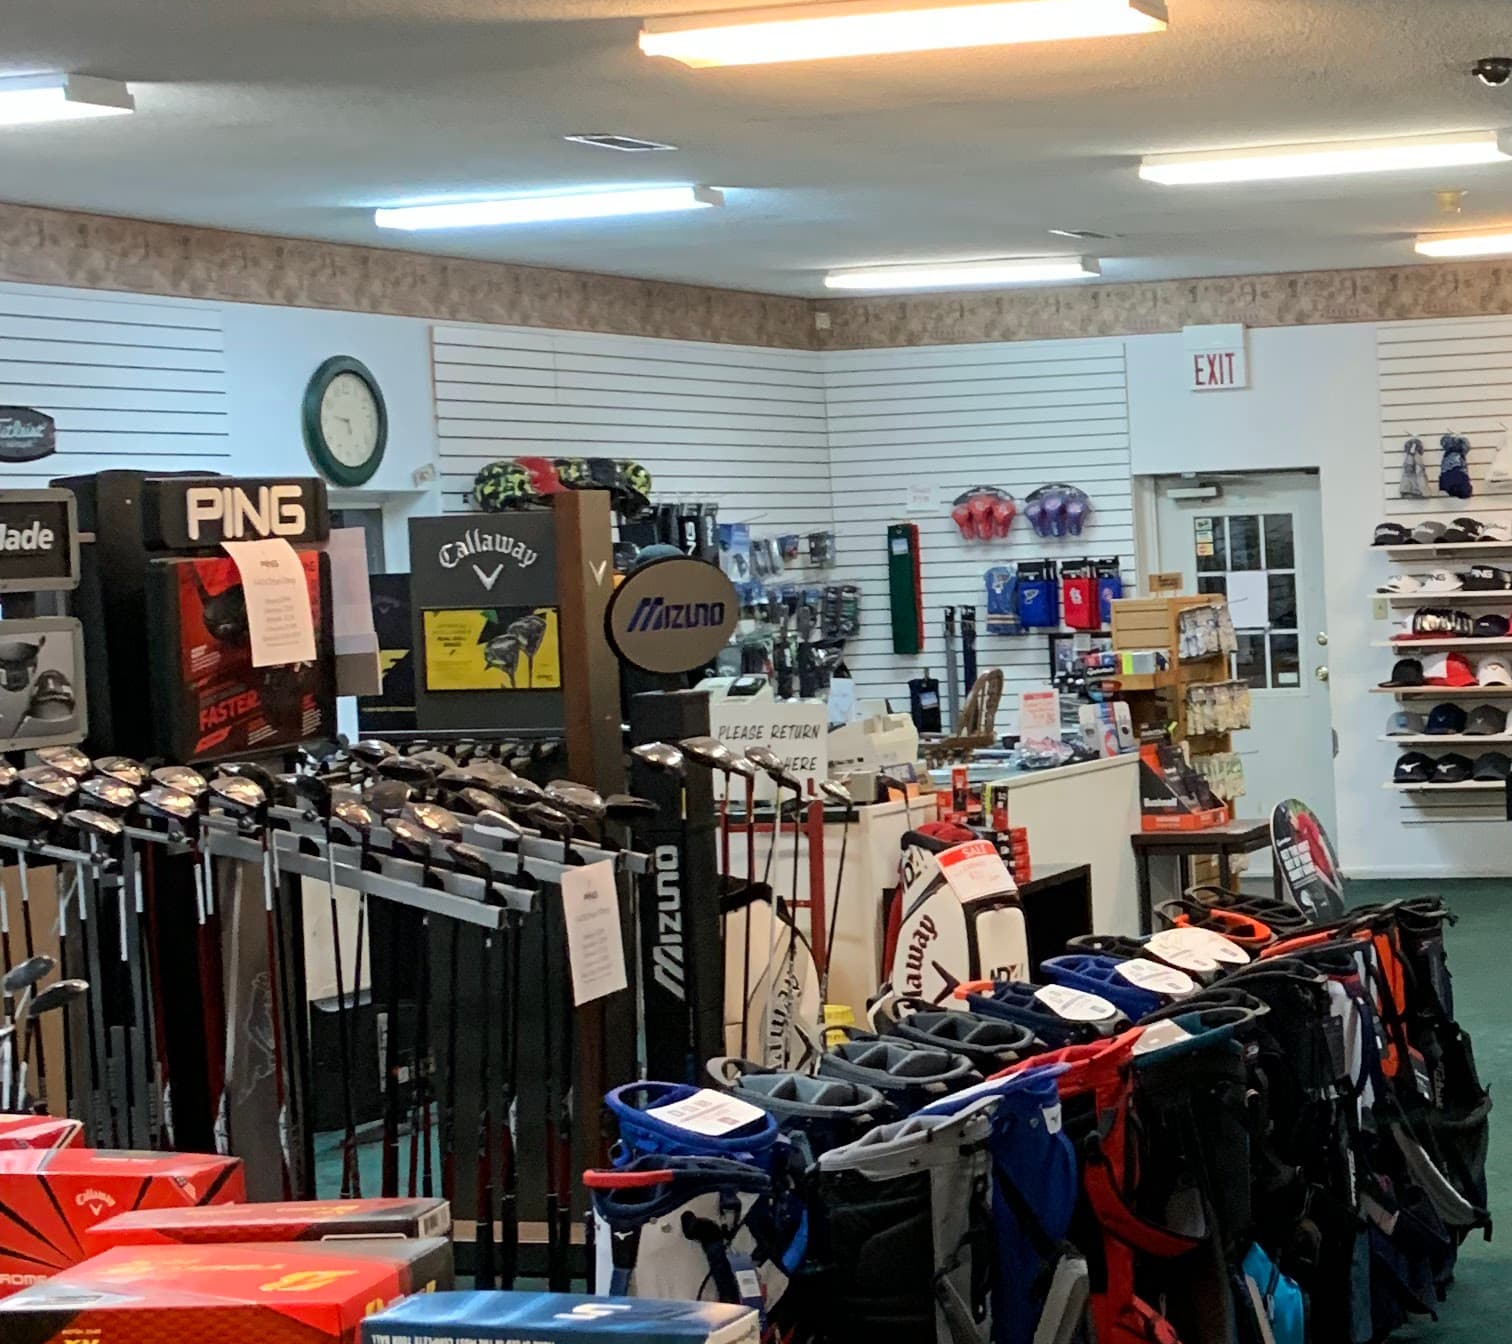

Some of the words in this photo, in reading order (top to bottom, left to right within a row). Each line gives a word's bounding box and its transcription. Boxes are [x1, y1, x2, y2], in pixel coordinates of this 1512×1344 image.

[1193, 352, 1236, 387] EXIT
[185, 484, 307, 541] PING
[0, 521, 55, 552] ade
[438, 528, 539, 569] Callaway
[718, 724, 764, 741] PLEASE
[771, 722, 822, 740] RETURN
[783, 755, 818, 773] HERE
